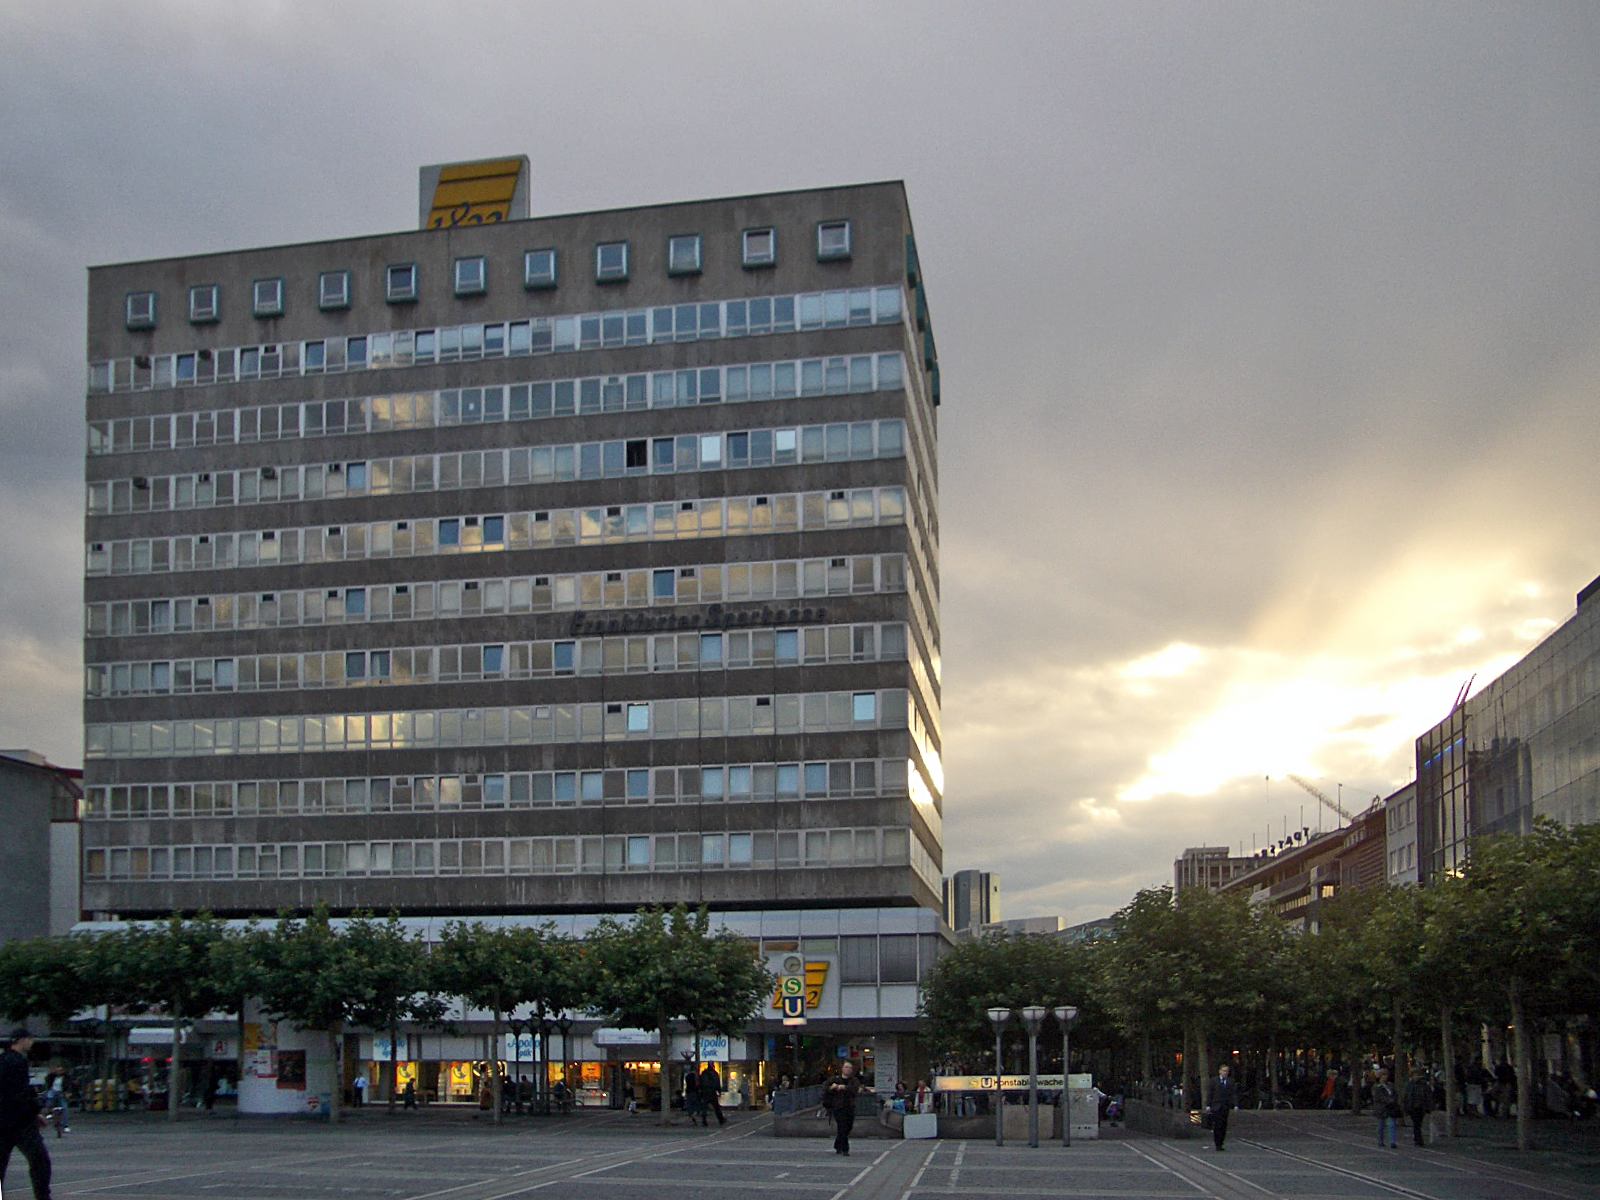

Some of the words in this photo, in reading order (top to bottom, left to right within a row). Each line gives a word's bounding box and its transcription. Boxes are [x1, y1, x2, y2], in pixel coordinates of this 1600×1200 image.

[787, 979, 799, 993] S
[785, 999, 801, 1016] U
[507, 1036, 541, 1049] Apolo
